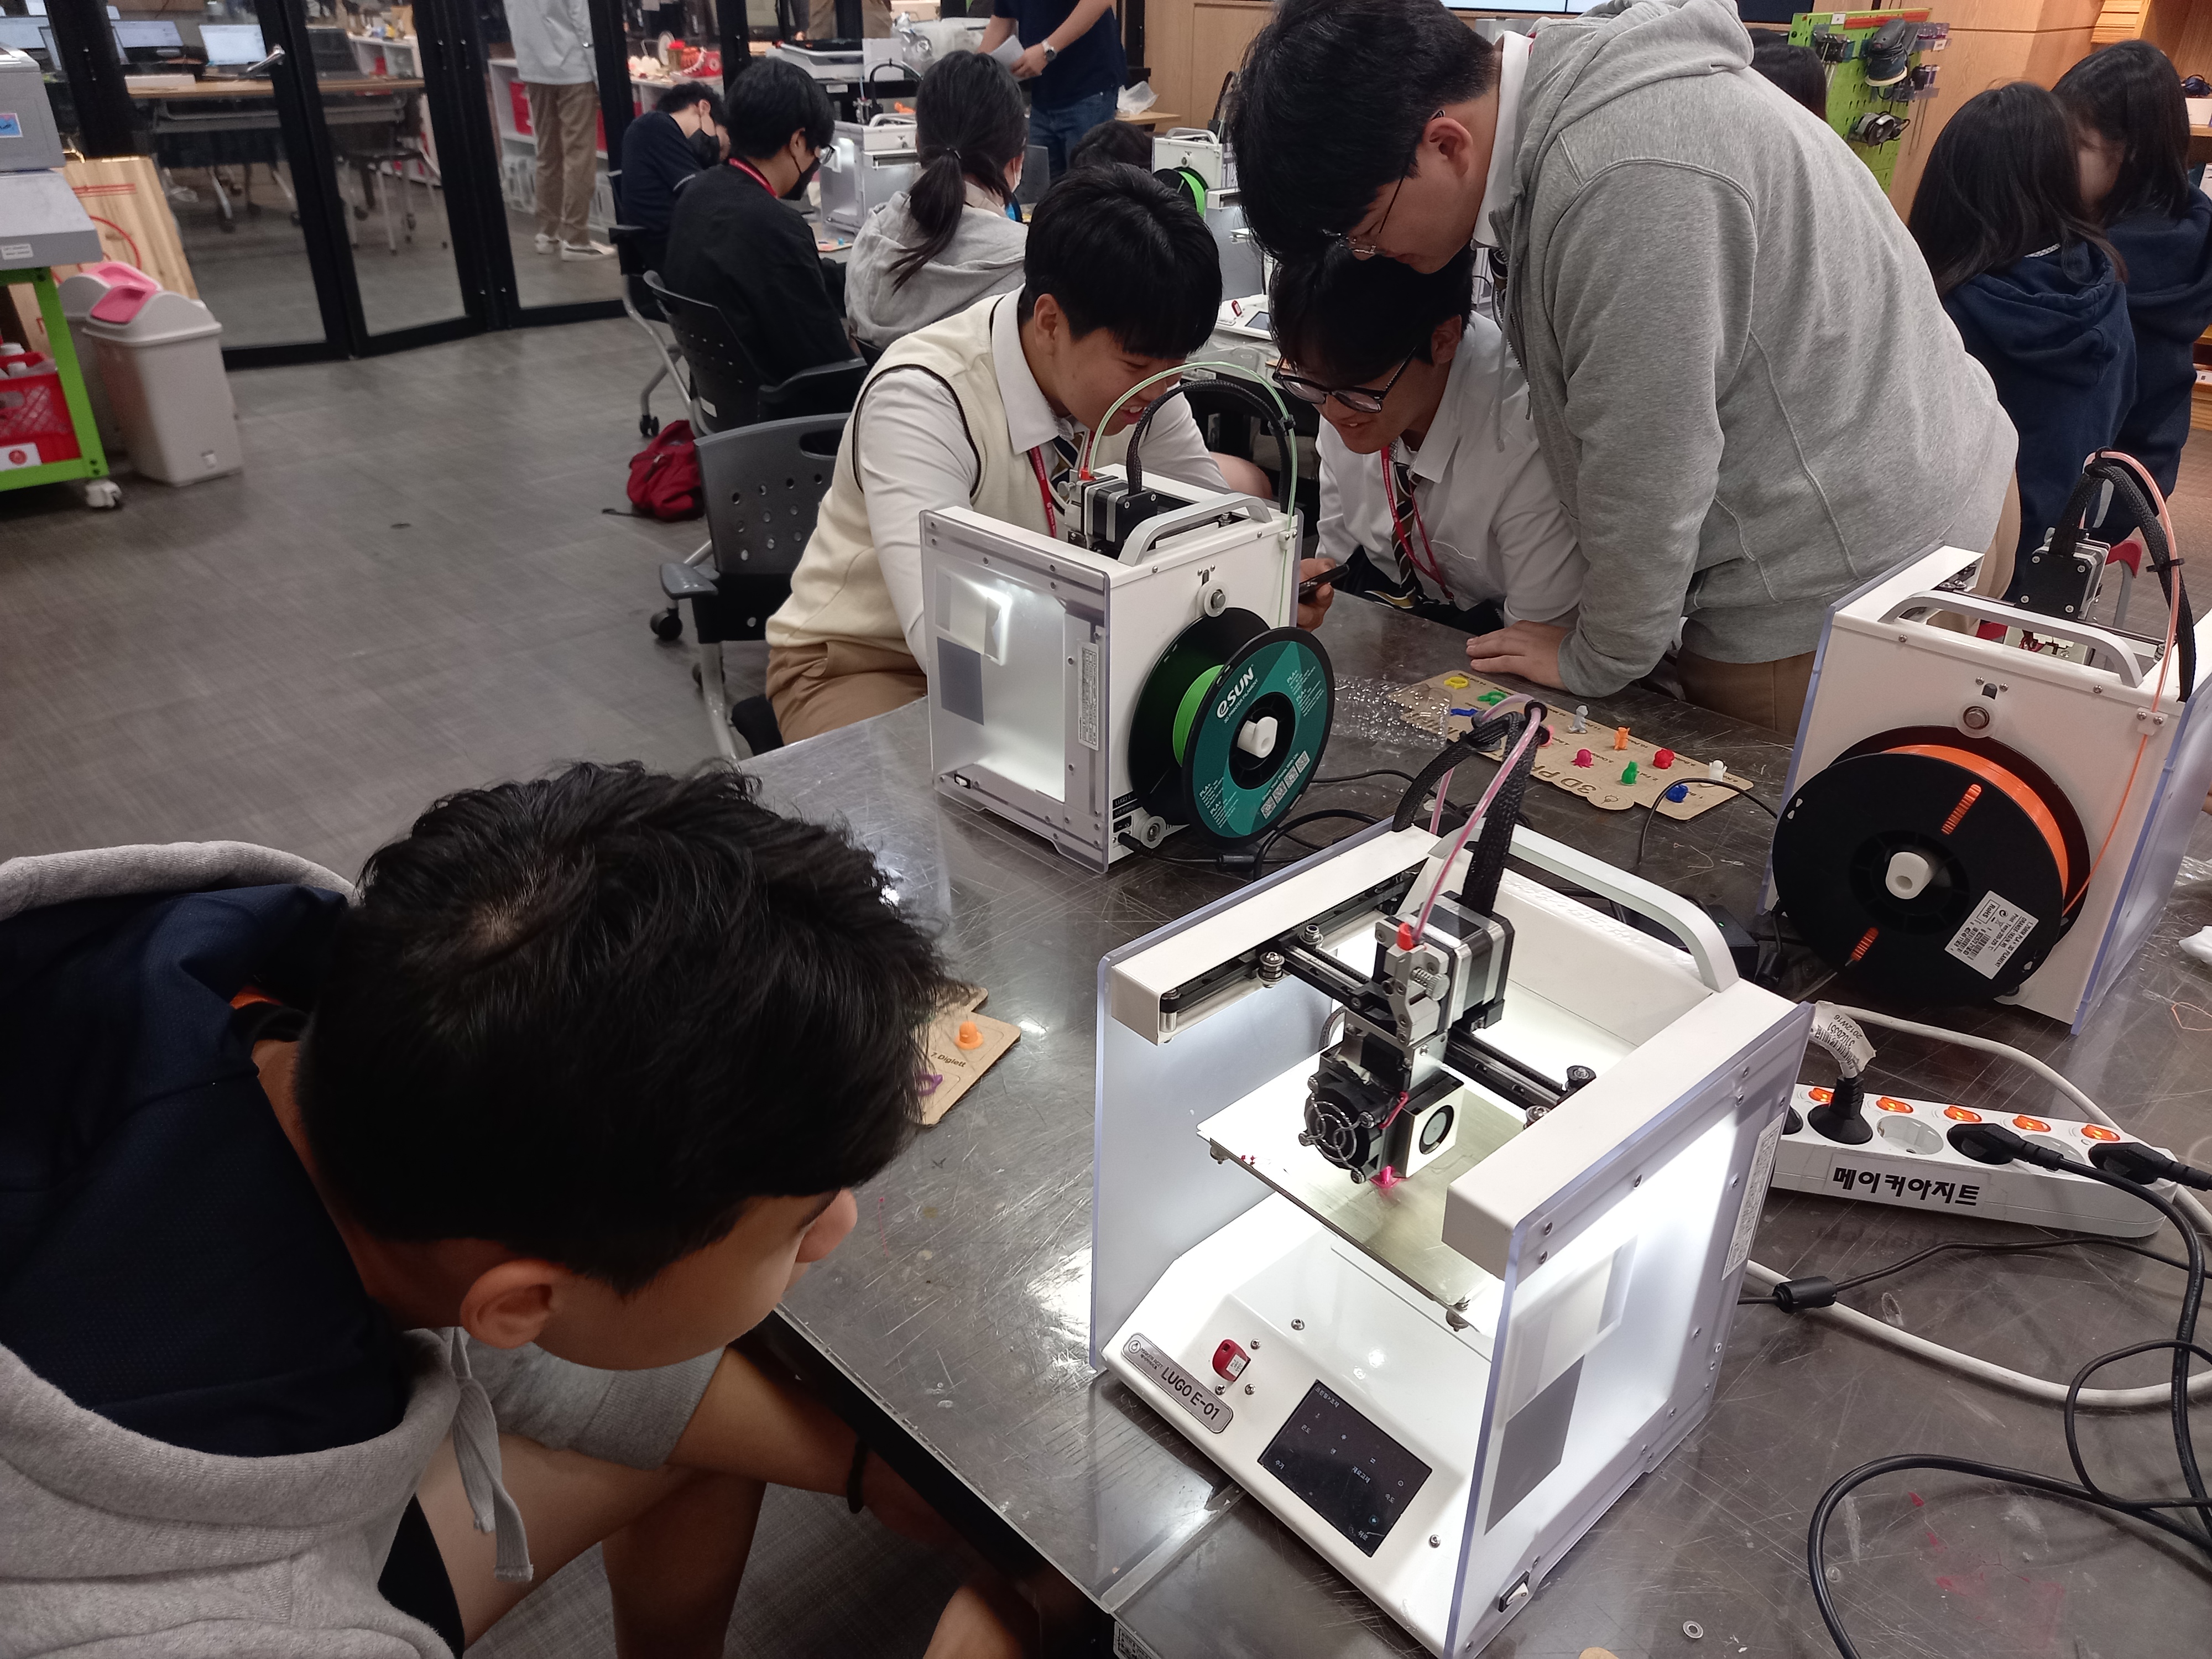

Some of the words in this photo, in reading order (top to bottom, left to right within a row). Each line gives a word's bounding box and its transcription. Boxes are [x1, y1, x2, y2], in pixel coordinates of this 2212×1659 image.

[1217, 666, 1254, 718] eSUN
[1228, 698, 1243, 717] PRINTER
[1242, 678, 1258, 700] FILAMENT
[1199, 783, 1211, 797] PLA+
[1561, 778, 1597, 794] 3D
[1210, 801, 1221, 815] PLA+
[1982, 904, 1995, 918] RoHS
[1994, 950, 2010, 967] FILAMENT
[1834, 1015, 1863, 1039] 2012W16
[930, 1052, 967, 1068] 7.Diglett
[1833, 1167, 1980, 1206] 메이커아지트
[1161, 1366, 1192, 1397] LUGO
[1190, 1391, 1220, 1420] E-01
